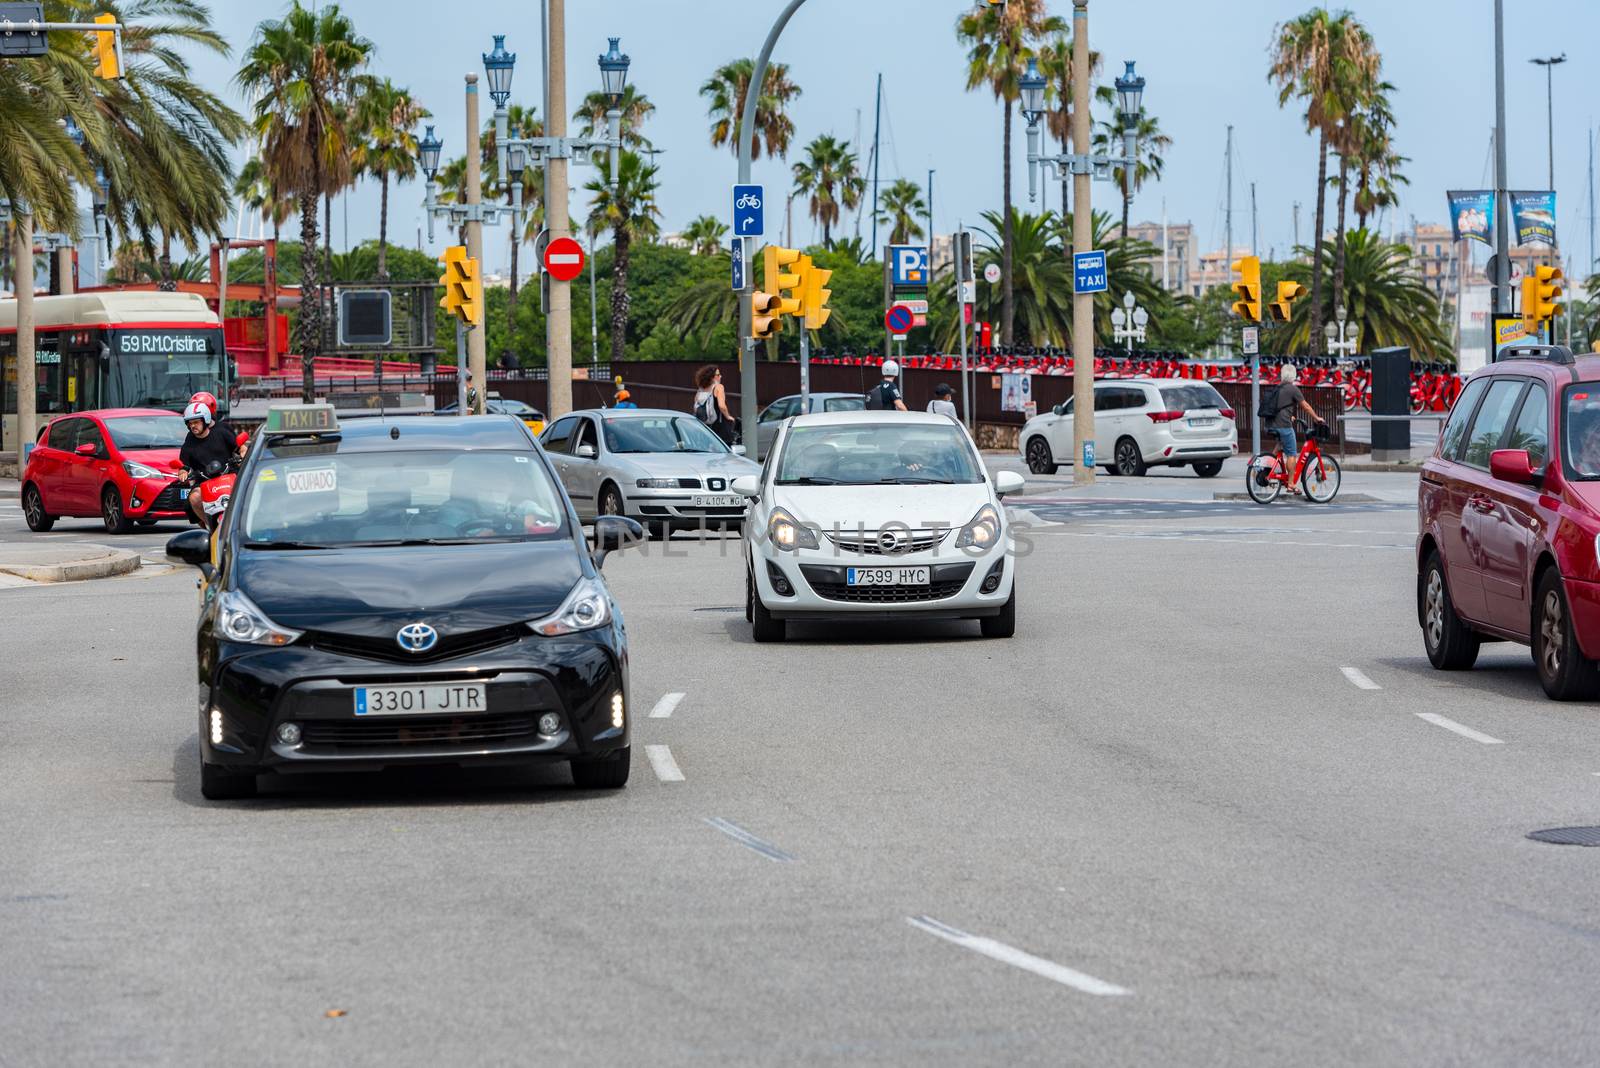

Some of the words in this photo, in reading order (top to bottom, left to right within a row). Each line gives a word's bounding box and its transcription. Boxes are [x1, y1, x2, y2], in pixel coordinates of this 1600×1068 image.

[899, 249, 921, 281] P
[1078, 274, 1104, 287] TAXI
[1499, 321, 1525, 336] ColaCa
[120, 335, 139, 352] 59
[141, 335, 206, 352] R.M.Cristina
[283, 410, 312, 428] TAXI
[289, 471, 335, 491] OCUPADO
[696, 497, 701, 505] B
[706, 497, 725, 505] 4104
[857, 570, 893, 583] 7599
[899, 569, 925, 583] HYC
[371, 689, 426, 711] 3301
[438, 688, 479, 708] JTR
